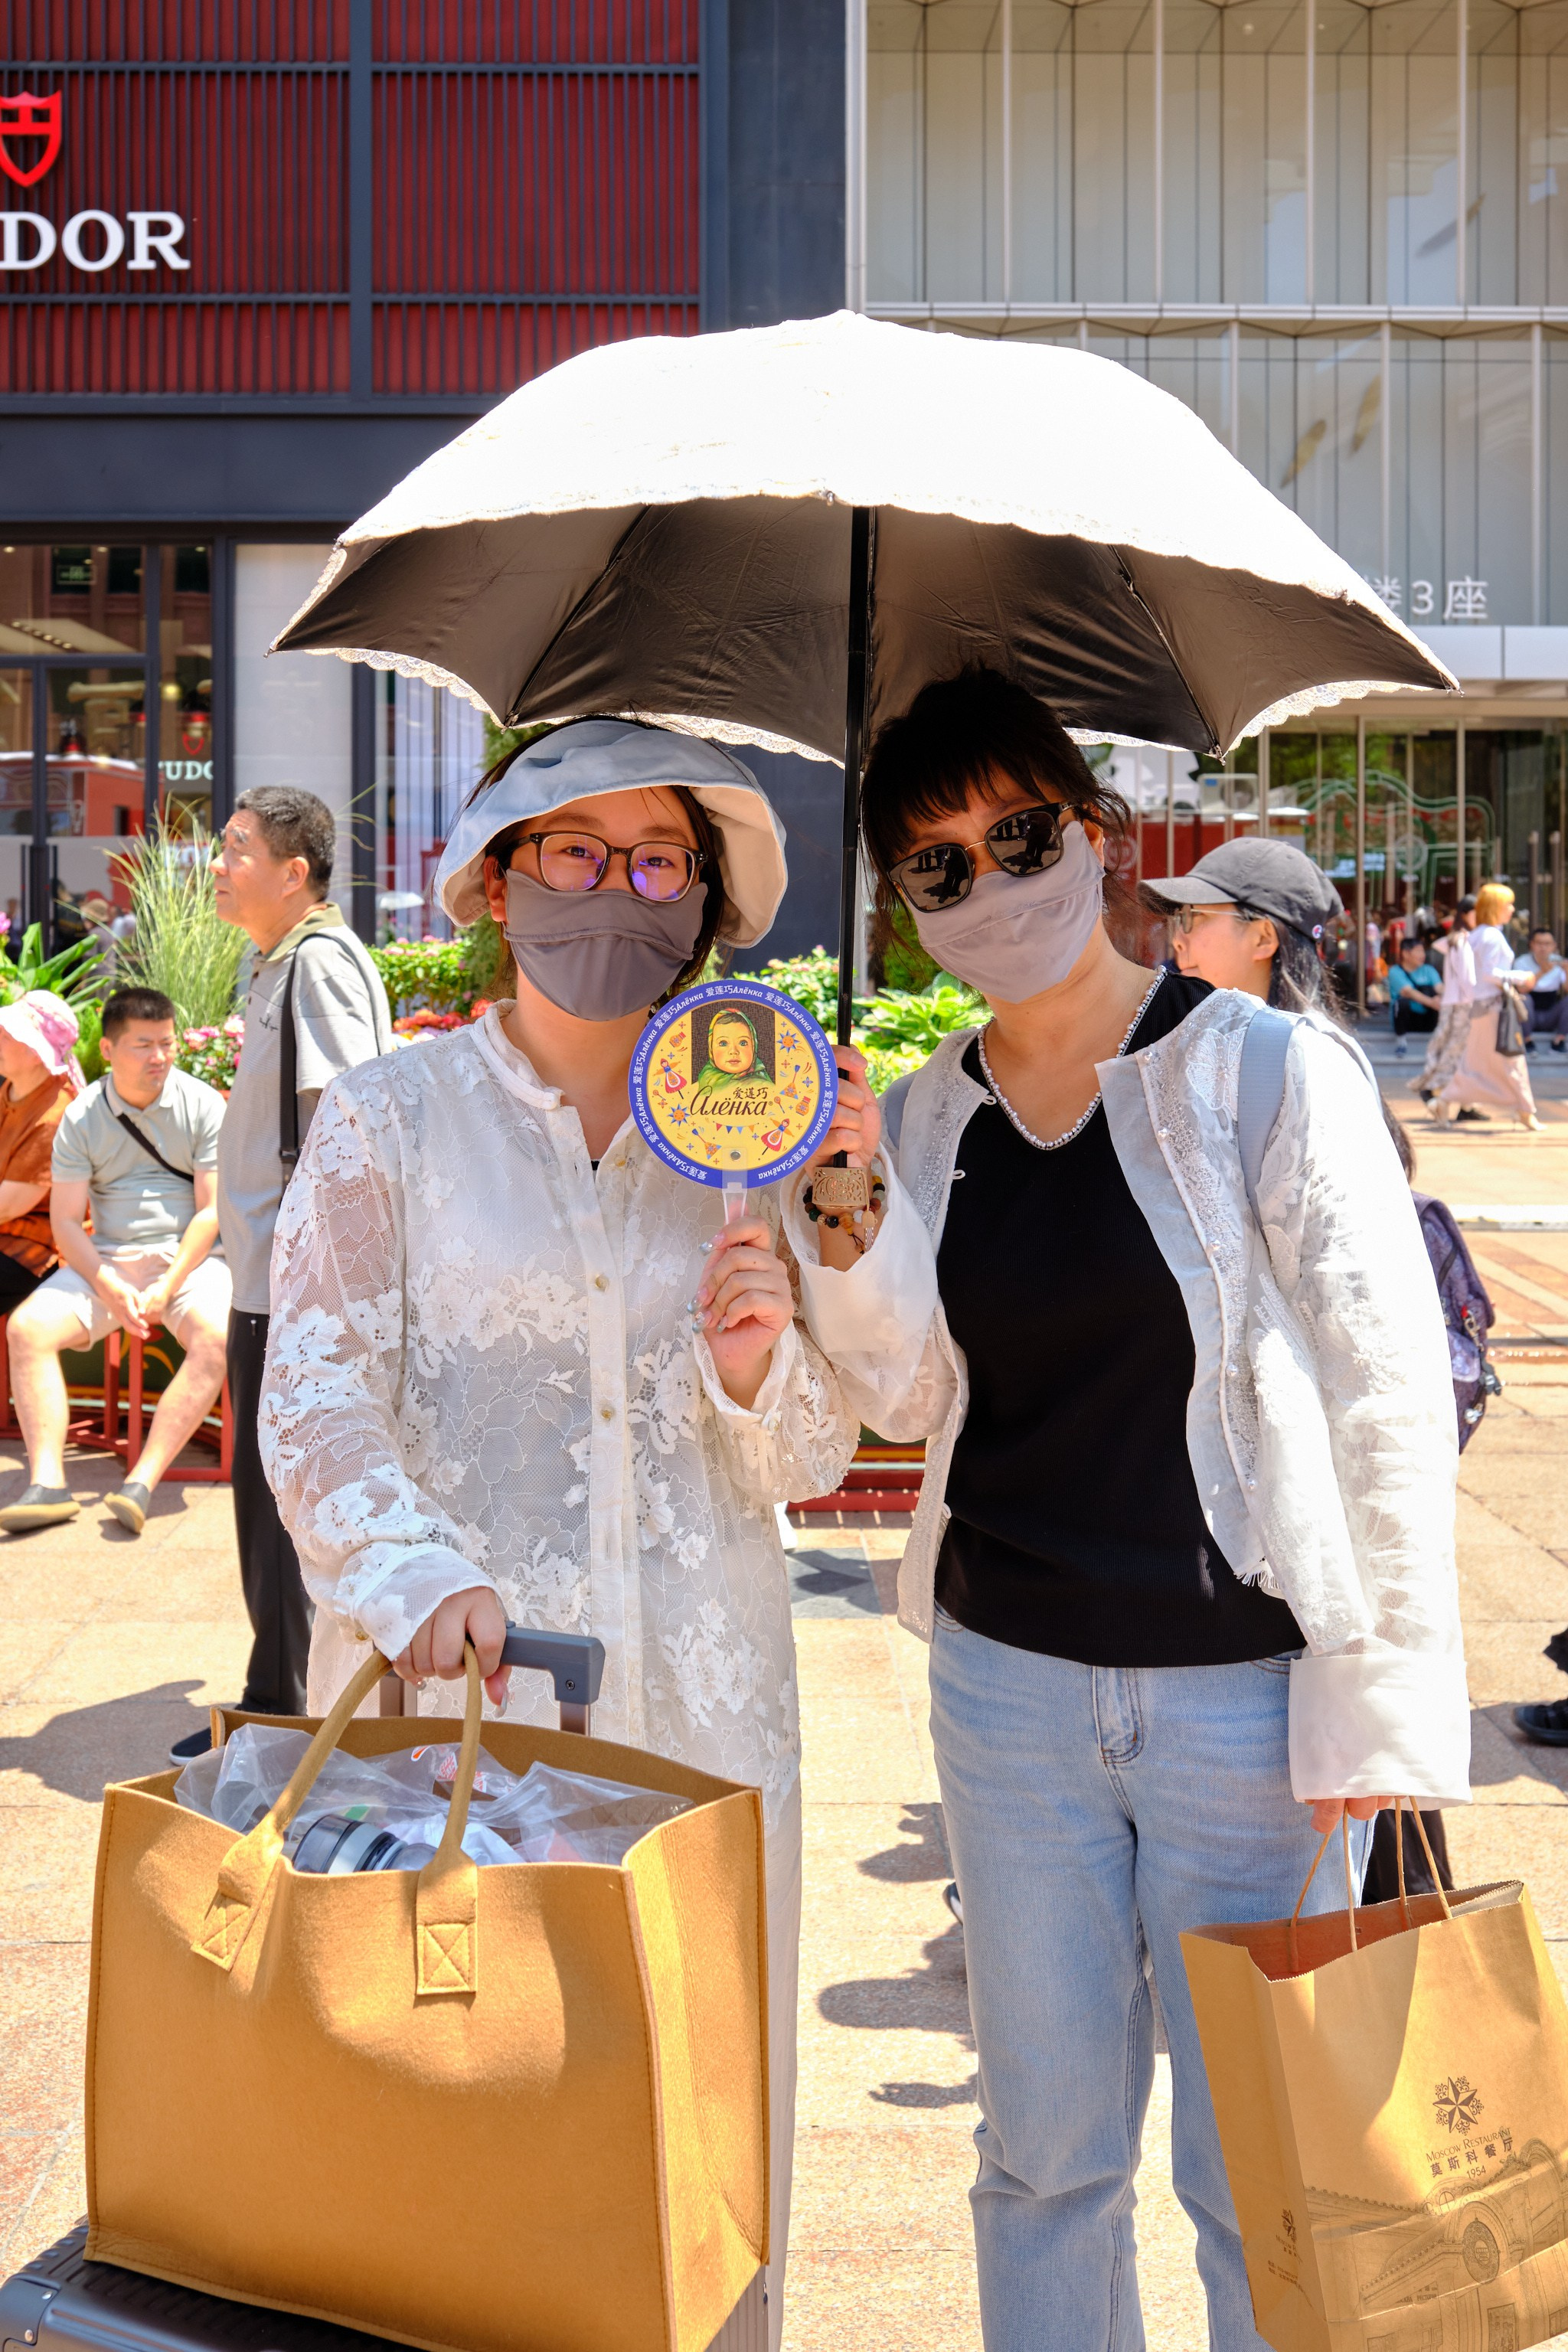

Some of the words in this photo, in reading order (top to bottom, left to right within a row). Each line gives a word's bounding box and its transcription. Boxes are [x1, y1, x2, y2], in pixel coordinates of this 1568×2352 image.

[0, 209, 191, 272] DOR
[690, 1085, 768, 1116] Алёнка
[733, 1087, 769, 1099] 爱莲巧
[1430, 2137, 1513, 2178] 莫斯科餐厅
[1466, 2165, 1486, 2179] 1954
